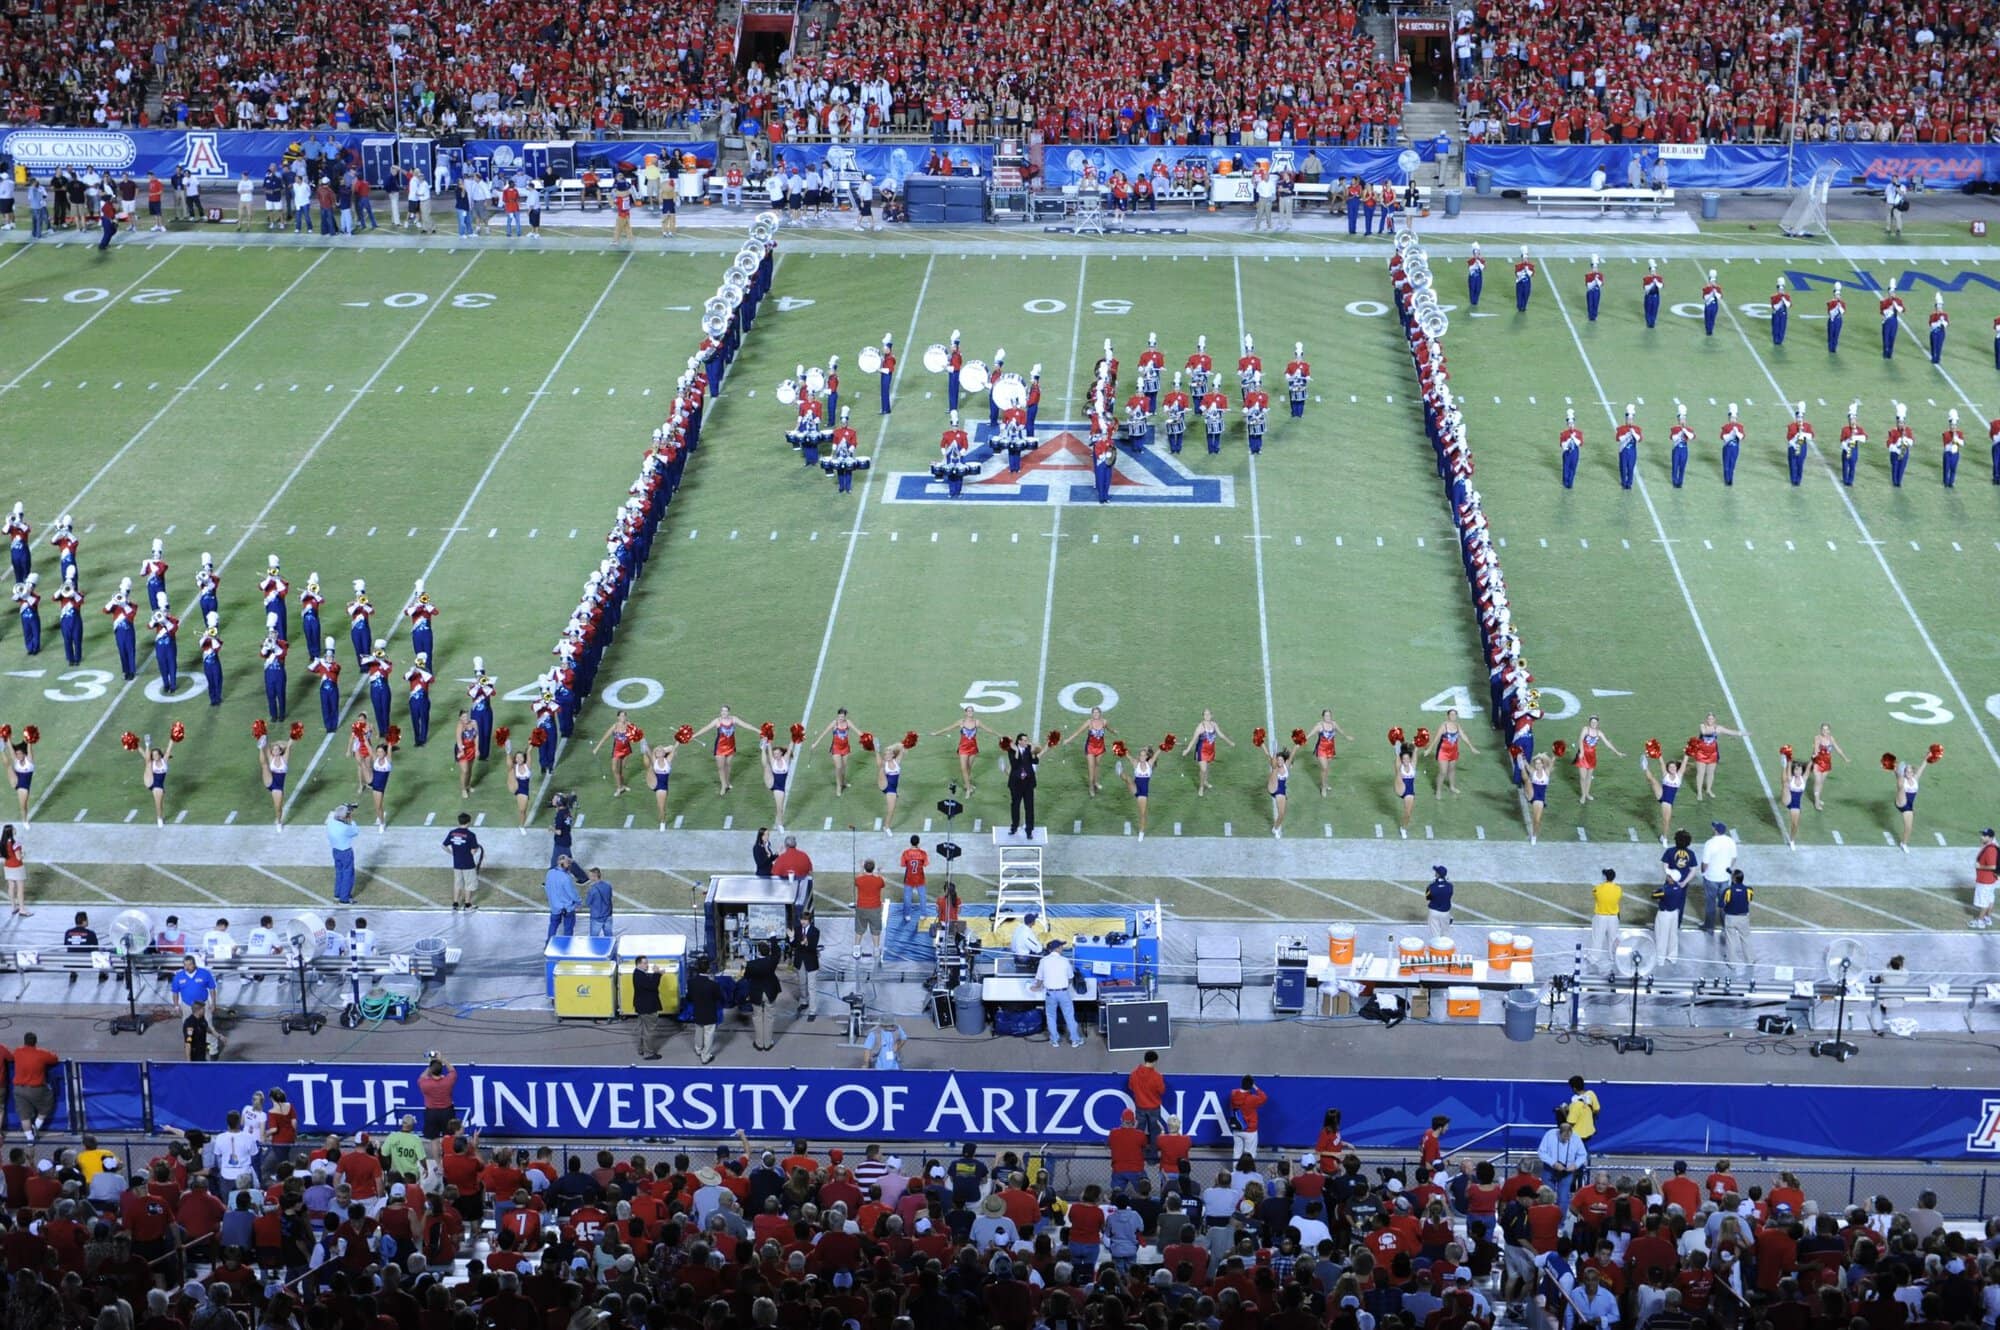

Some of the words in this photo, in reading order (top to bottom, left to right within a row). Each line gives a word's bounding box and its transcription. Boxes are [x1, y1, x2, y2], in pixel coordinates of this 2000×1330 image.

[1411, 22, 1434, 30] SECTION
[17, 143, 48, 156] SOL
[52, 143, 122, 157] CASINOS
[178, 132, 228, 178] A
[1863, 157, 1982, 179] ARIZONA
[288, 1073, 408, 1126] THE
[825, 1084, 908, 1132] OF
[398, 1146, 415, 1158] 500
[516, 1213, 527, 1235] 7
[576, 1221, 600, 1240] 45
